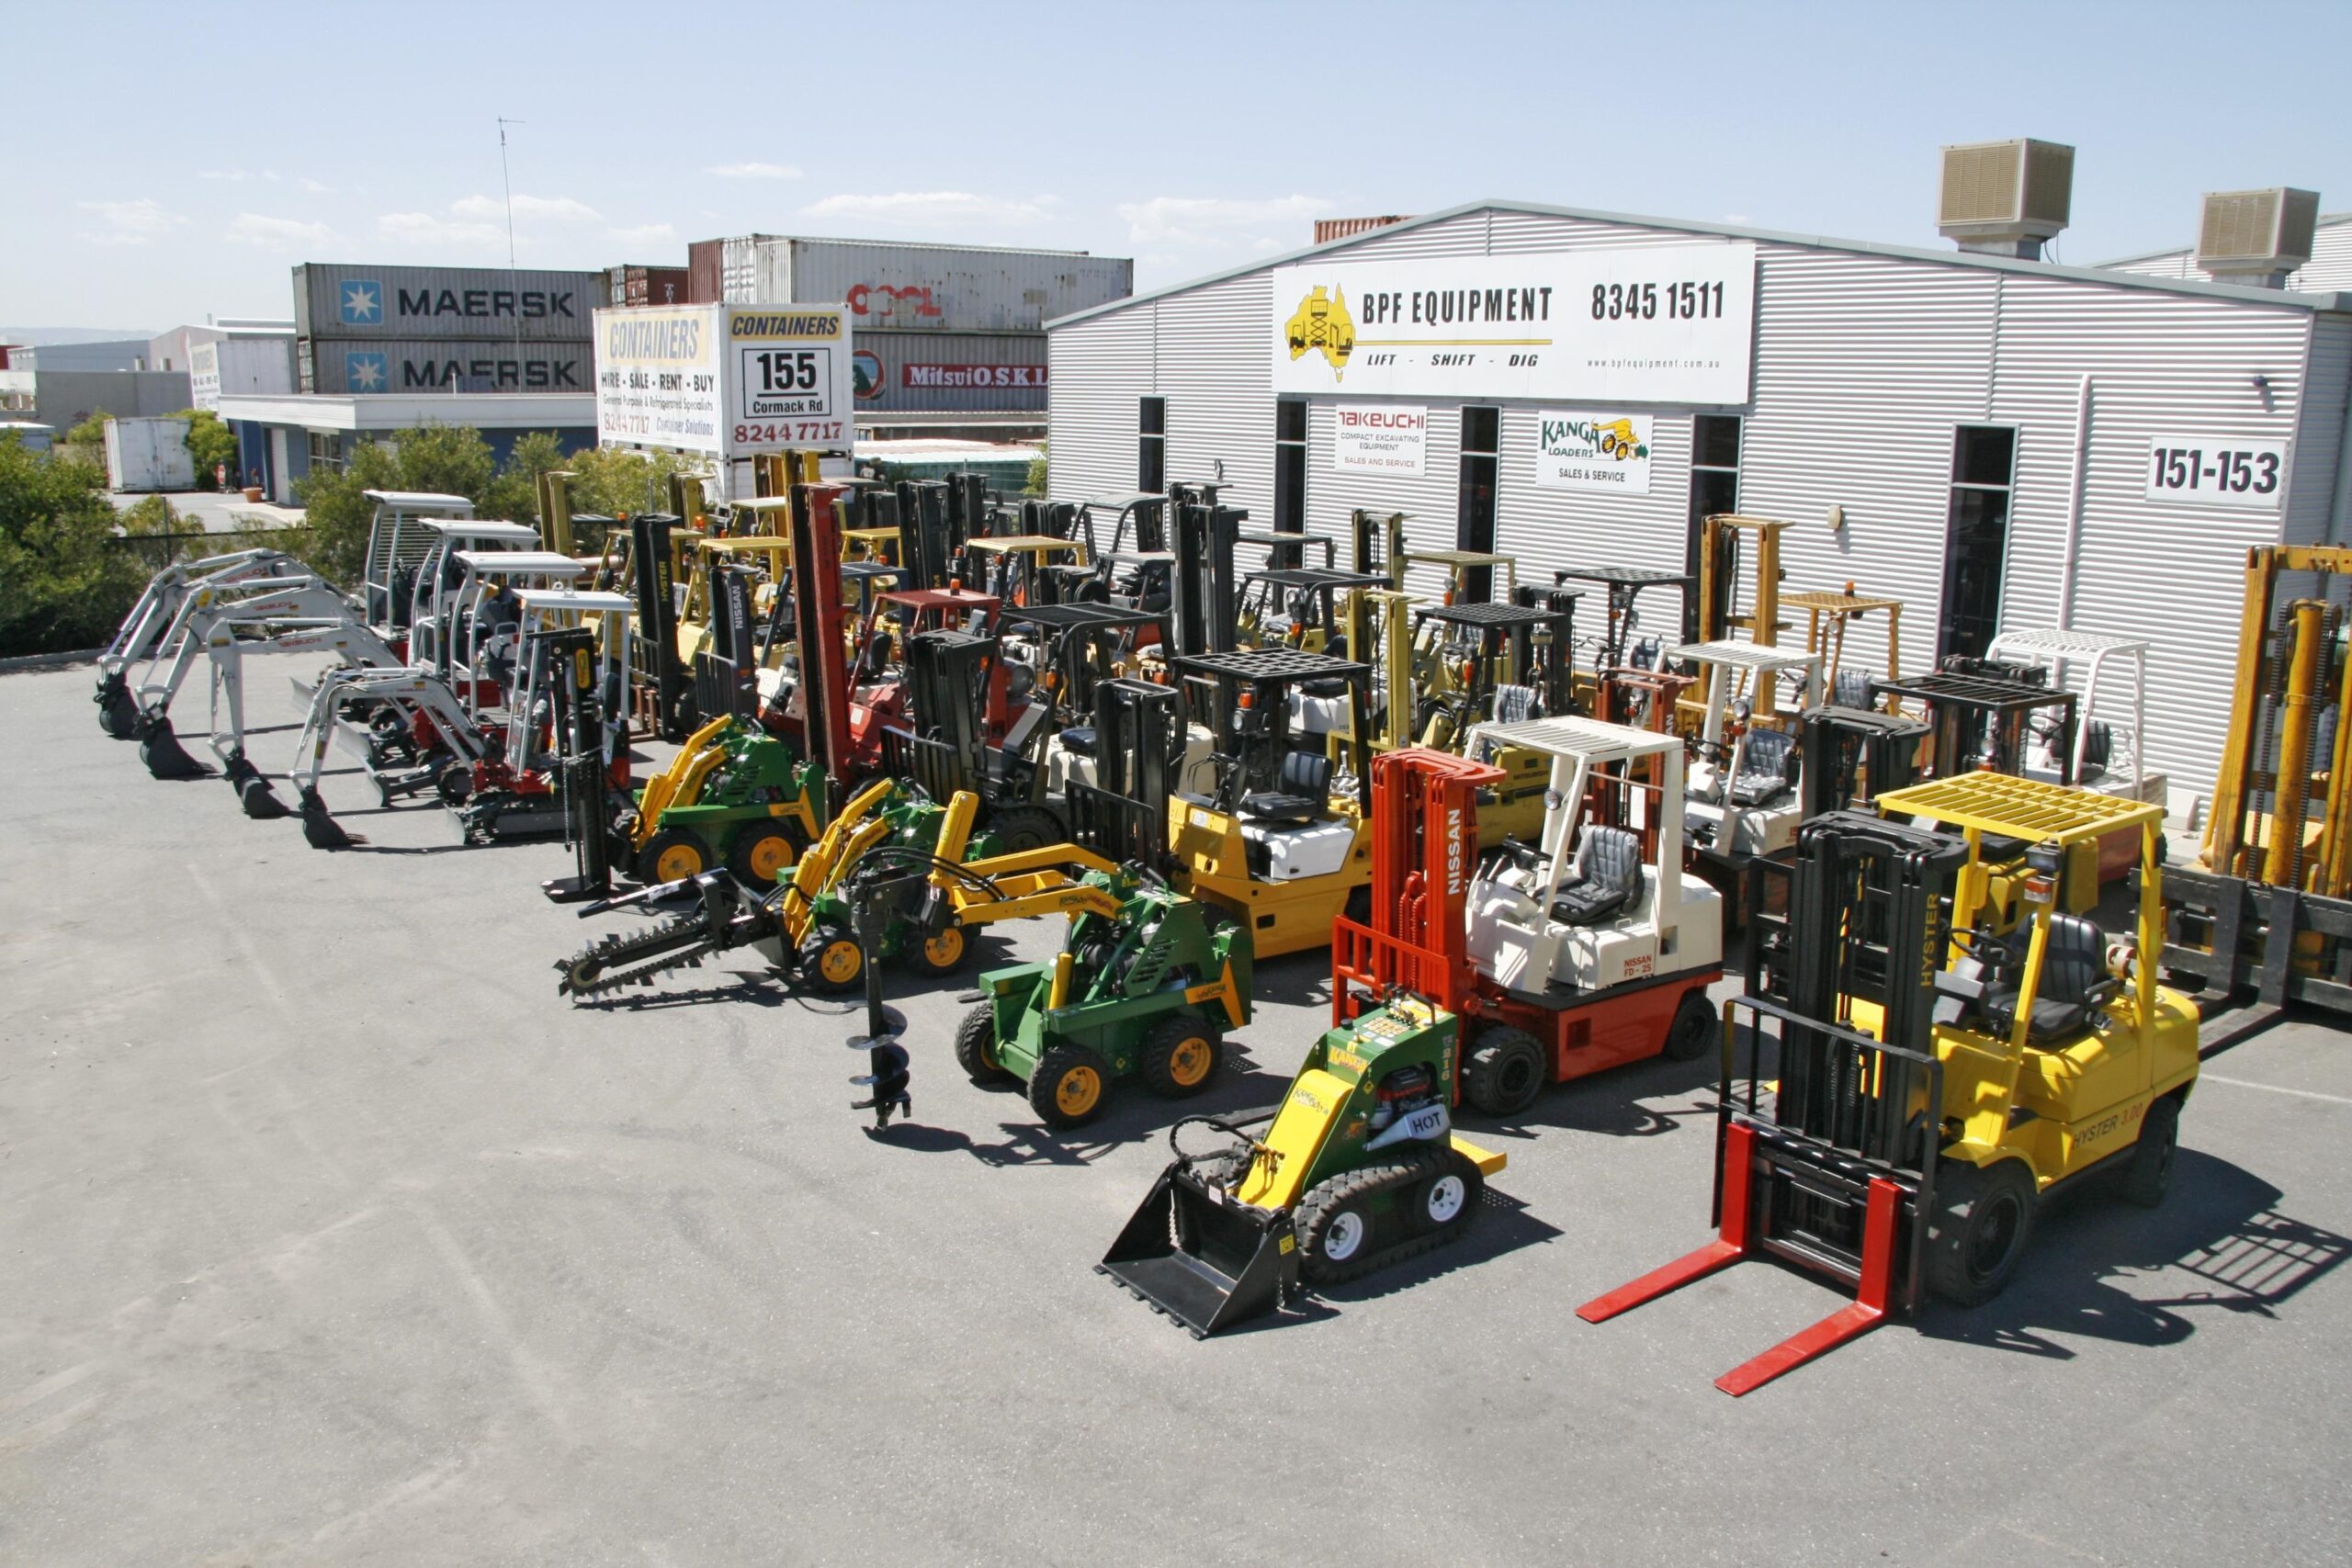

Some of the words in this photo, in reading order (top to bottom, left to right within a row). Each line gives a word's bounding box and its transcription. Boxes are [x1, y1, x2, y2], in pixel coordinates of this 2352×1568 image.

[399, 288, 575, 319] MAERSK
[1363, 292, 1402, 324] BPF
[1412, 287, 1553, 326] EQUIPMENT
[1591, 283, 1657, 321] 8345
[1667, 280, 1724, 319] 1511
[731, 316, 839, 336] CONTAINERS
[609, 319, 699, 360] CONTAINERS
[1367, 354, 1396, 367] LIFT
[1430, 354, 1476, 367] SHIFT
[1508, 354, 1539, 367] DIG
[1587, 358, 1721, 369] www.bpfequipment.com.au
[601, 372, 620, 389] HIRE
[629, 372, 649, 389] SALE
[659, 374, 682, 391] RENT
[694, 375, 715, 392] BUY
[756, 353, 817, 390] 155
[604, 394, 622, 407] General
[623, 395, 643, 410] Purpose
[650, 396, 682, 412] Refrigerated
[683, 398, 713, 413] Specialists
[753, 400, 805, 413] Cormack
[808, 400, 823, 412] Rd
[605, 413, 628, 432] 8244
[629, 415, 650, 434] 7717
[656, 417, 684, 433] Container
[684, 418, 714, 436] Solutions
[734, 423, 792, 443] 8244
[796, 422, 843, 441] 7717
[1340, 432, 1374, 441] COMPACT
[1375, 434, 1419, 443] EXCAVATING
[1359, 443, 1399, 451] EQUIPMENT
[1541, 420, 1601, 454] KANGA
[1344, 457, 1366, 465] SALES
[1368, 457, 1384, 466] AND
[1385, 458, 1416, 468] SERVICE
[1548, 447, 1594, 458] LOADERS
[1558, 468, 1582, 479] SALES
[1584, 470, 1590, 479] &
[1592, 469, 1625, 482] SERVICE
[2154, 447, 2280, 494] 151-153
[659, 560, 670, 602] HYSTER
[731, 585, 744, 630] NISSAN
[1448, 808, 1461, 896] NISSAN
[1920, 893, 1939, 987] HYSTER
[1623, 954, 1652, 968] NISSAN
[1623, 968, 1634, 977] FD
[1412, 1112, 1442, 1134] HOT
[2073, 1114, 2119, 1148] HYSTER
